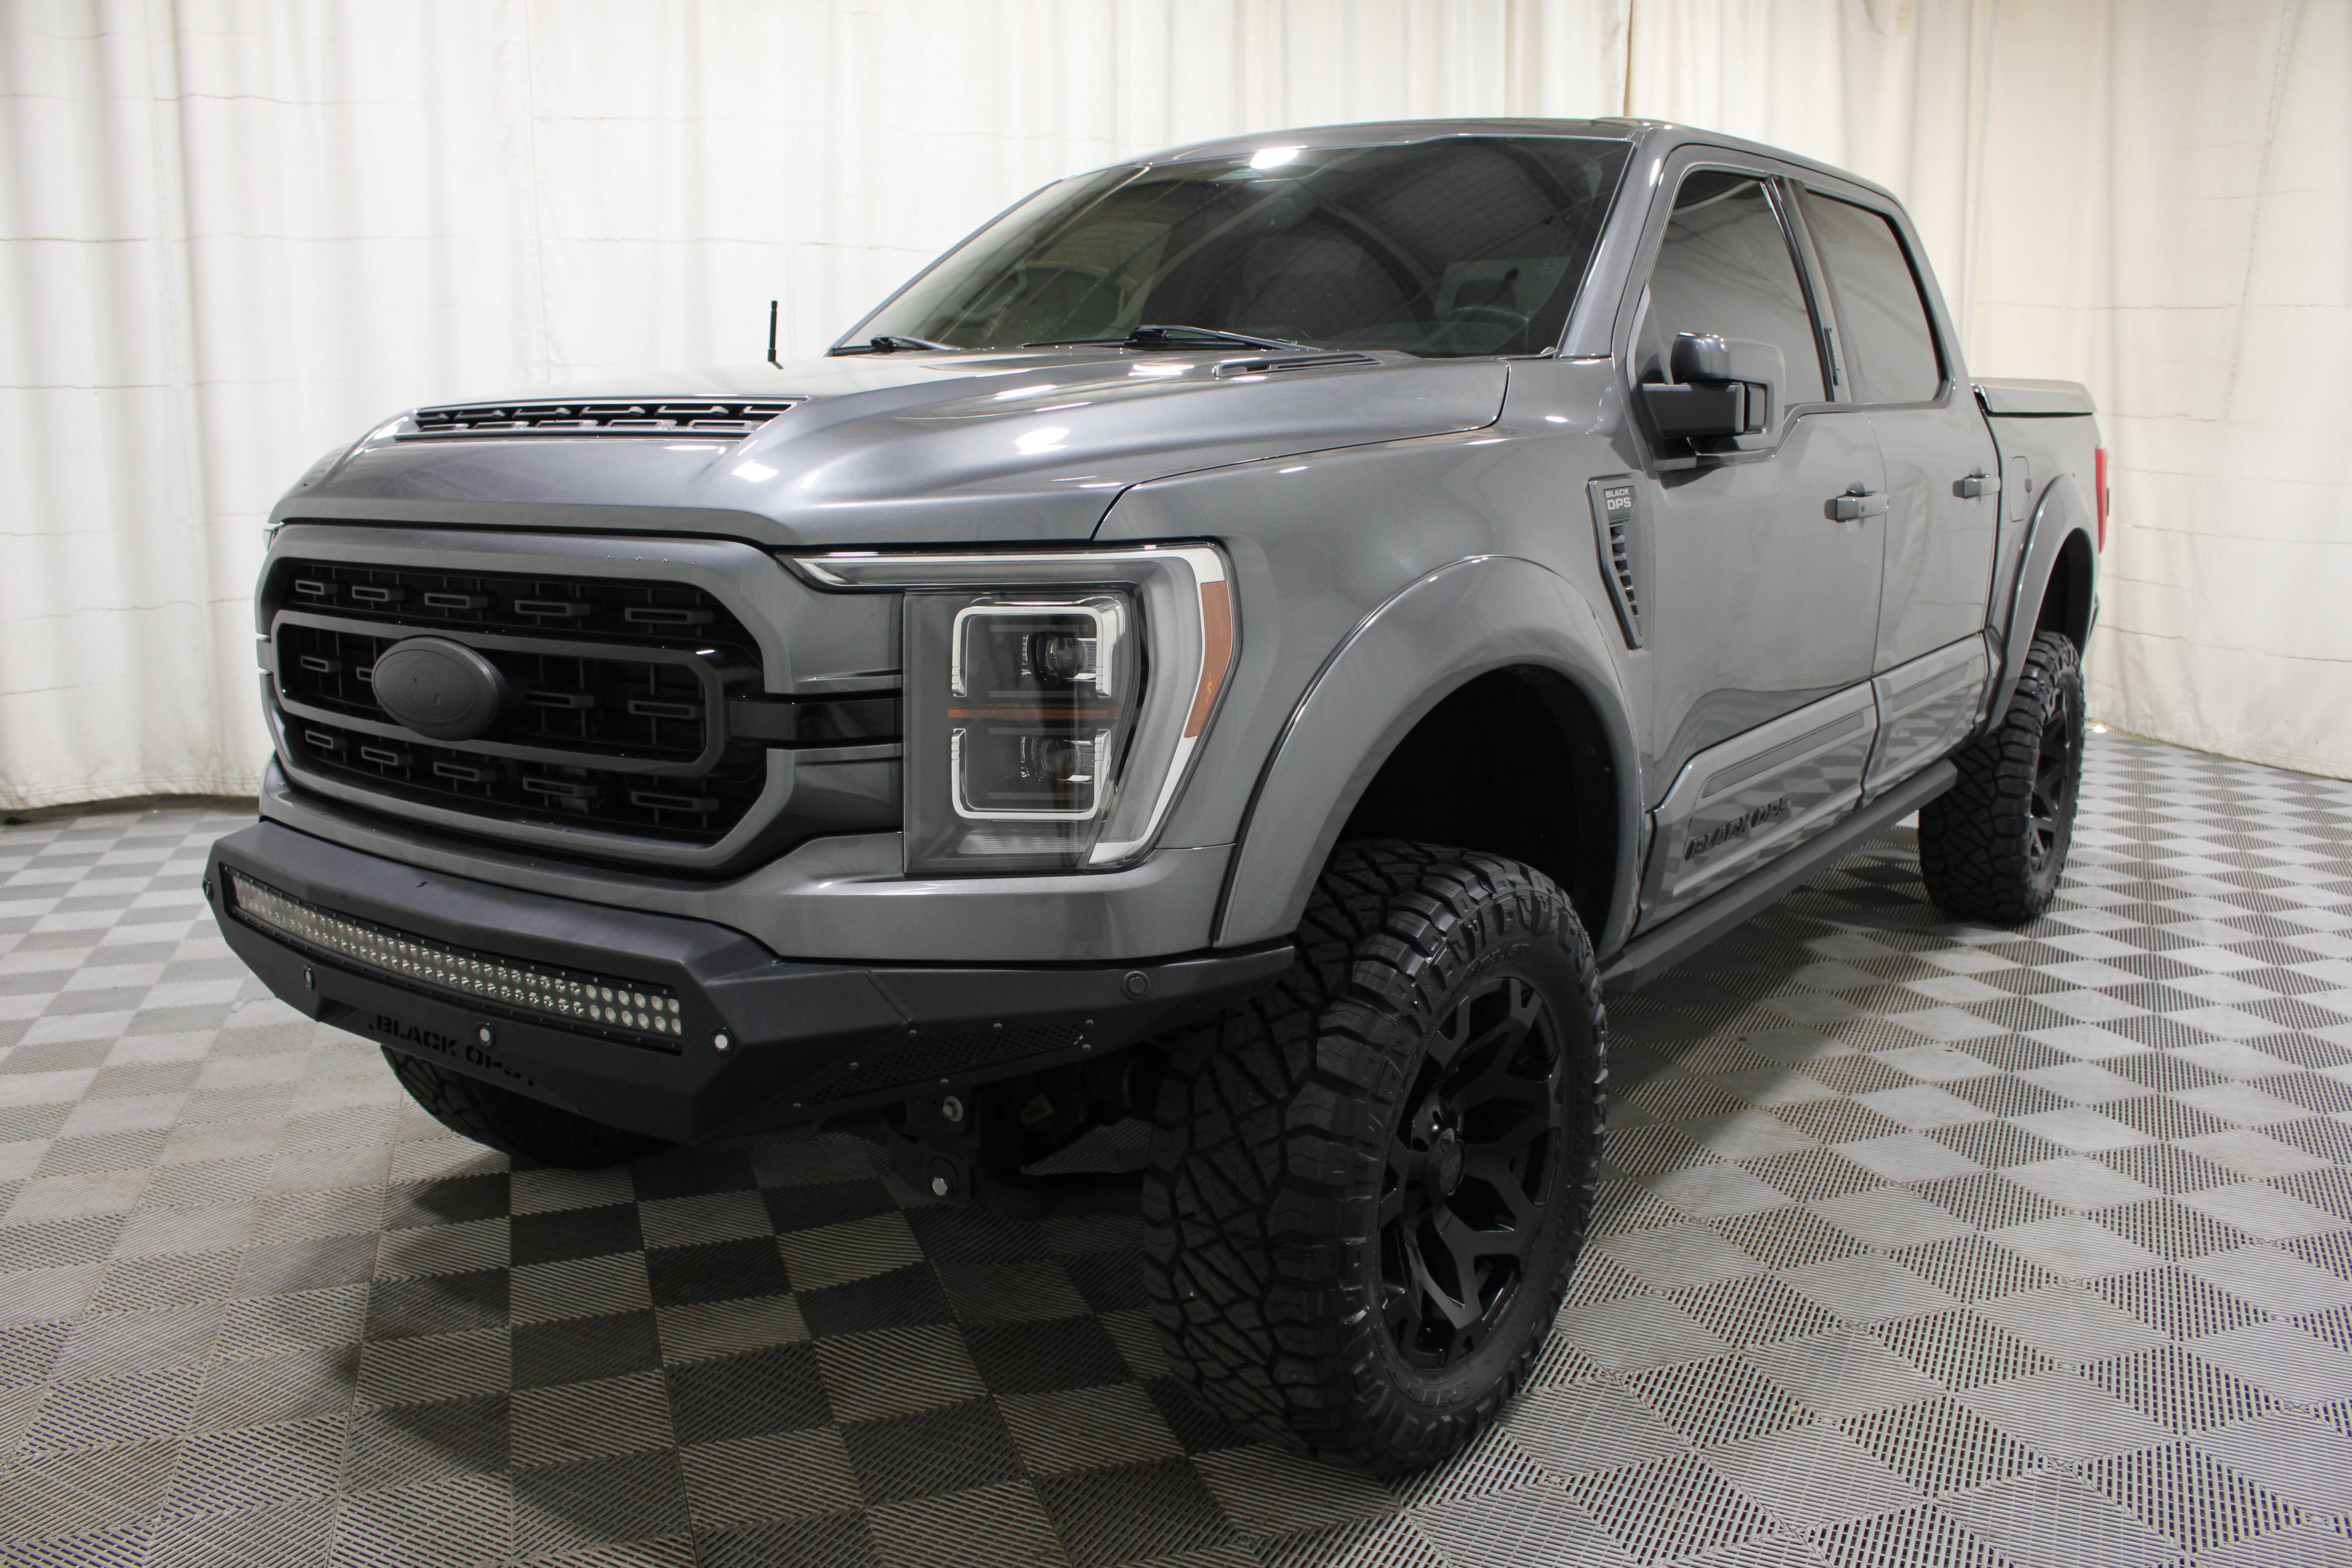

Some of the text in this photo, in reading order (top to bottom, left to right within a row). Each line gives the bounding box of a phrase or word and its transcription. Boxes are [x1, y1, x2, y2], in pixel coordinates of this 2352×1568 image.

[1605, 488, 1629, 498] BLACK
[1607, 497, 1631, 510] OPS
[376, 1014, 458, 1058] BLACK
